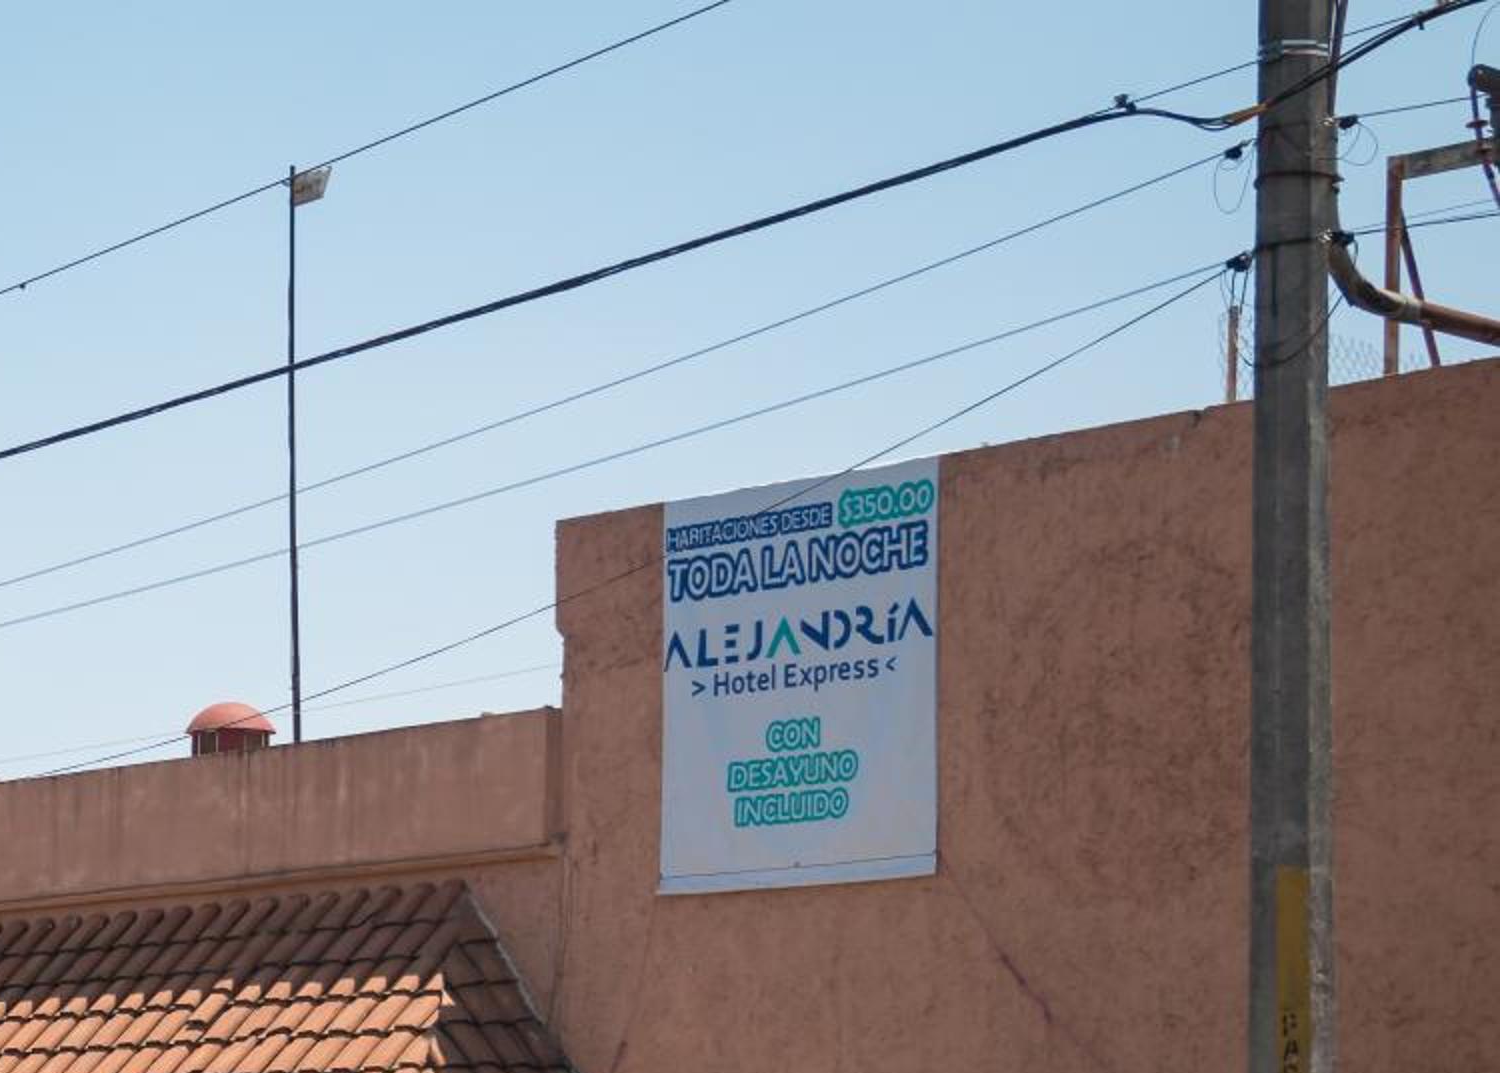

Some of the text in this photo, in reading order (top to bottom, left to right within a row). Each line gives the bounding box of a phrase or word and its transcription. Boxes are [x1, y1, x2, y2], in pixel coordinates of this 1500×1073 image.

[666, 479, 934, 551] HABITACIONES DESDE $350.00
[668, 520, 928, 602] TODA LA NOCHE
[713, 657, 879, 697] Hotel Express
[766, 717, 821, 752] CON
[727, 750, 858, 793] DESAYUNO
[734, 789, 848, 828] INCLUIDO
